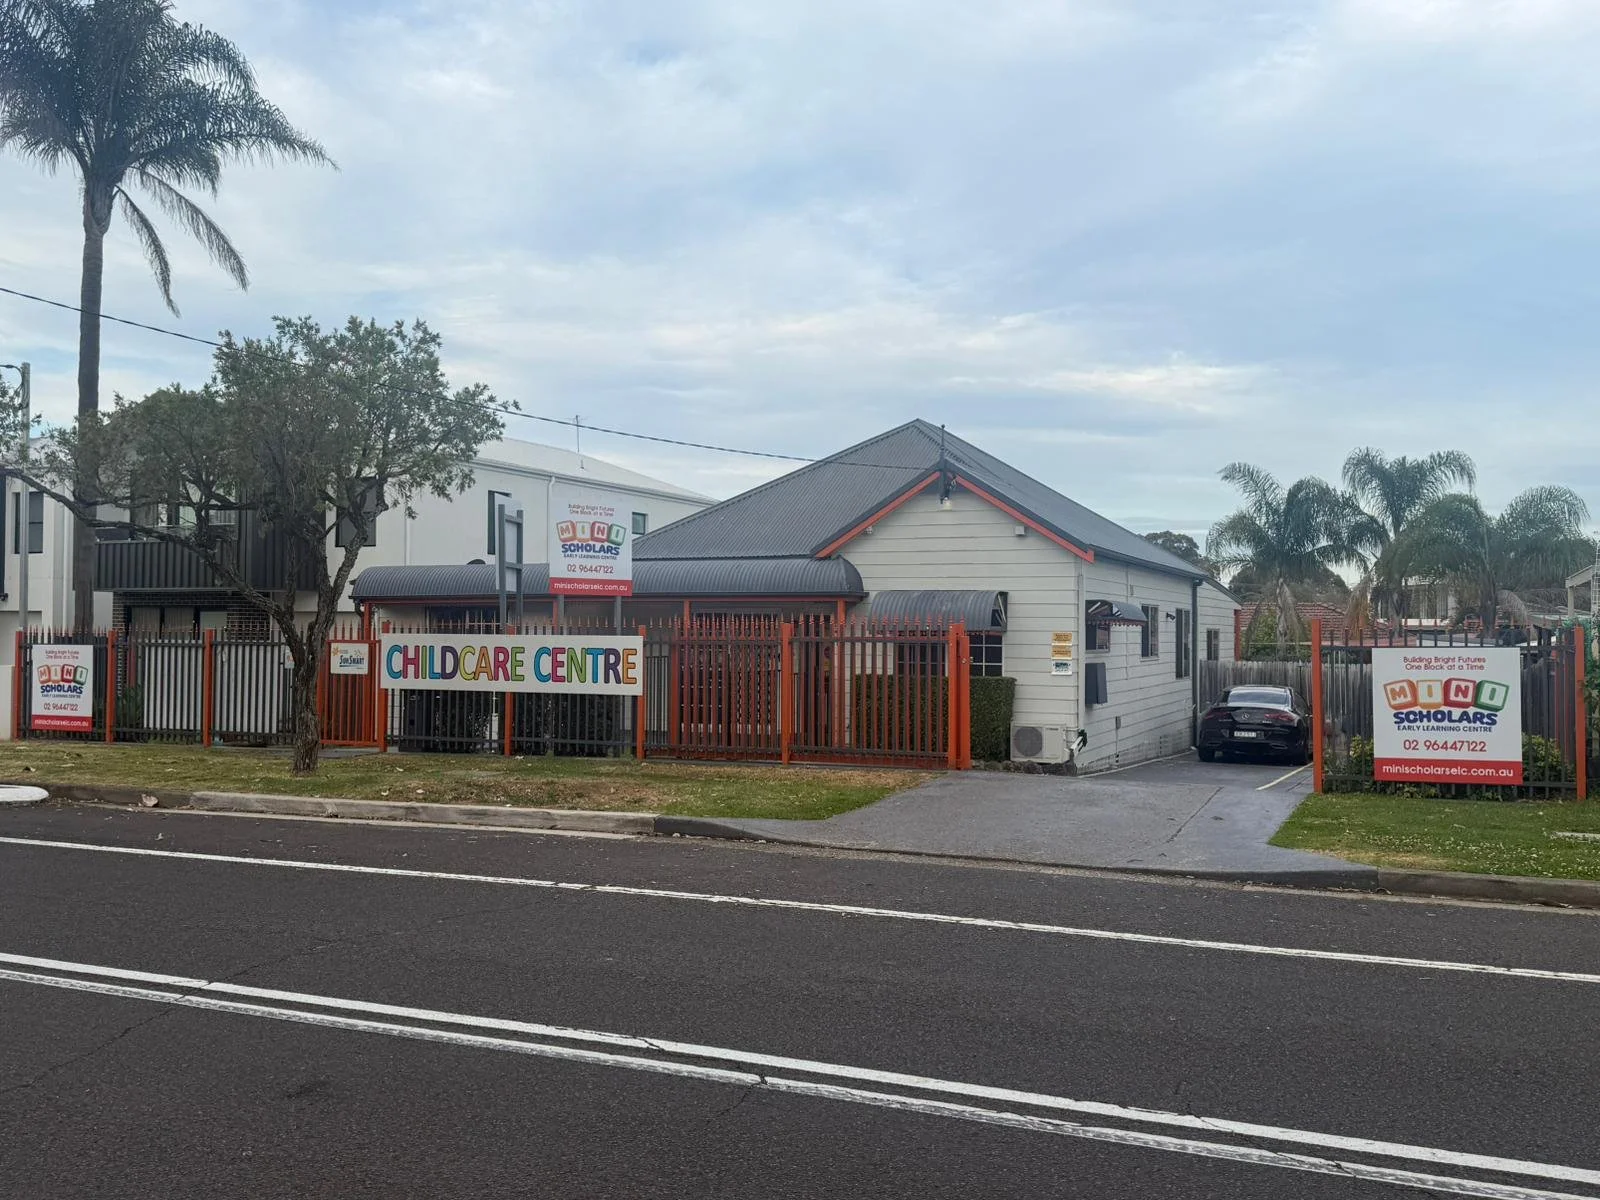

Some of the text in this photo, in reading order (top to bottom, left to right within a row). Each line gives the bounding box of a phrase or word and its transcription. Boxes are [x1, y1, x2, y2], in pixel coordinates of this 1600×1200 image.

[559, 523, 622, 540] MINI
[561, 543, 621, 556] SCHOLARS
[567, 564, 614, 574] 02 96447122
[386, 645, 638, 685] CHILDCARE CENTRE
[1403, 656, 1487, 665] Building Bright Futures
[1424, 663, 1445, 671] Block
[39, 667, 85, 680] MINI
[41, 684, 84, 695] SCHOLARS
[1388, 682, 1501, 703] MINI
[43, 702, 51, 710] 02
[1392, 709, 1499, 726] SCHOLARS
[1462, 725, 1493, 733] CENTRE
[1403, 739, 1487, 752] 02 96447122
